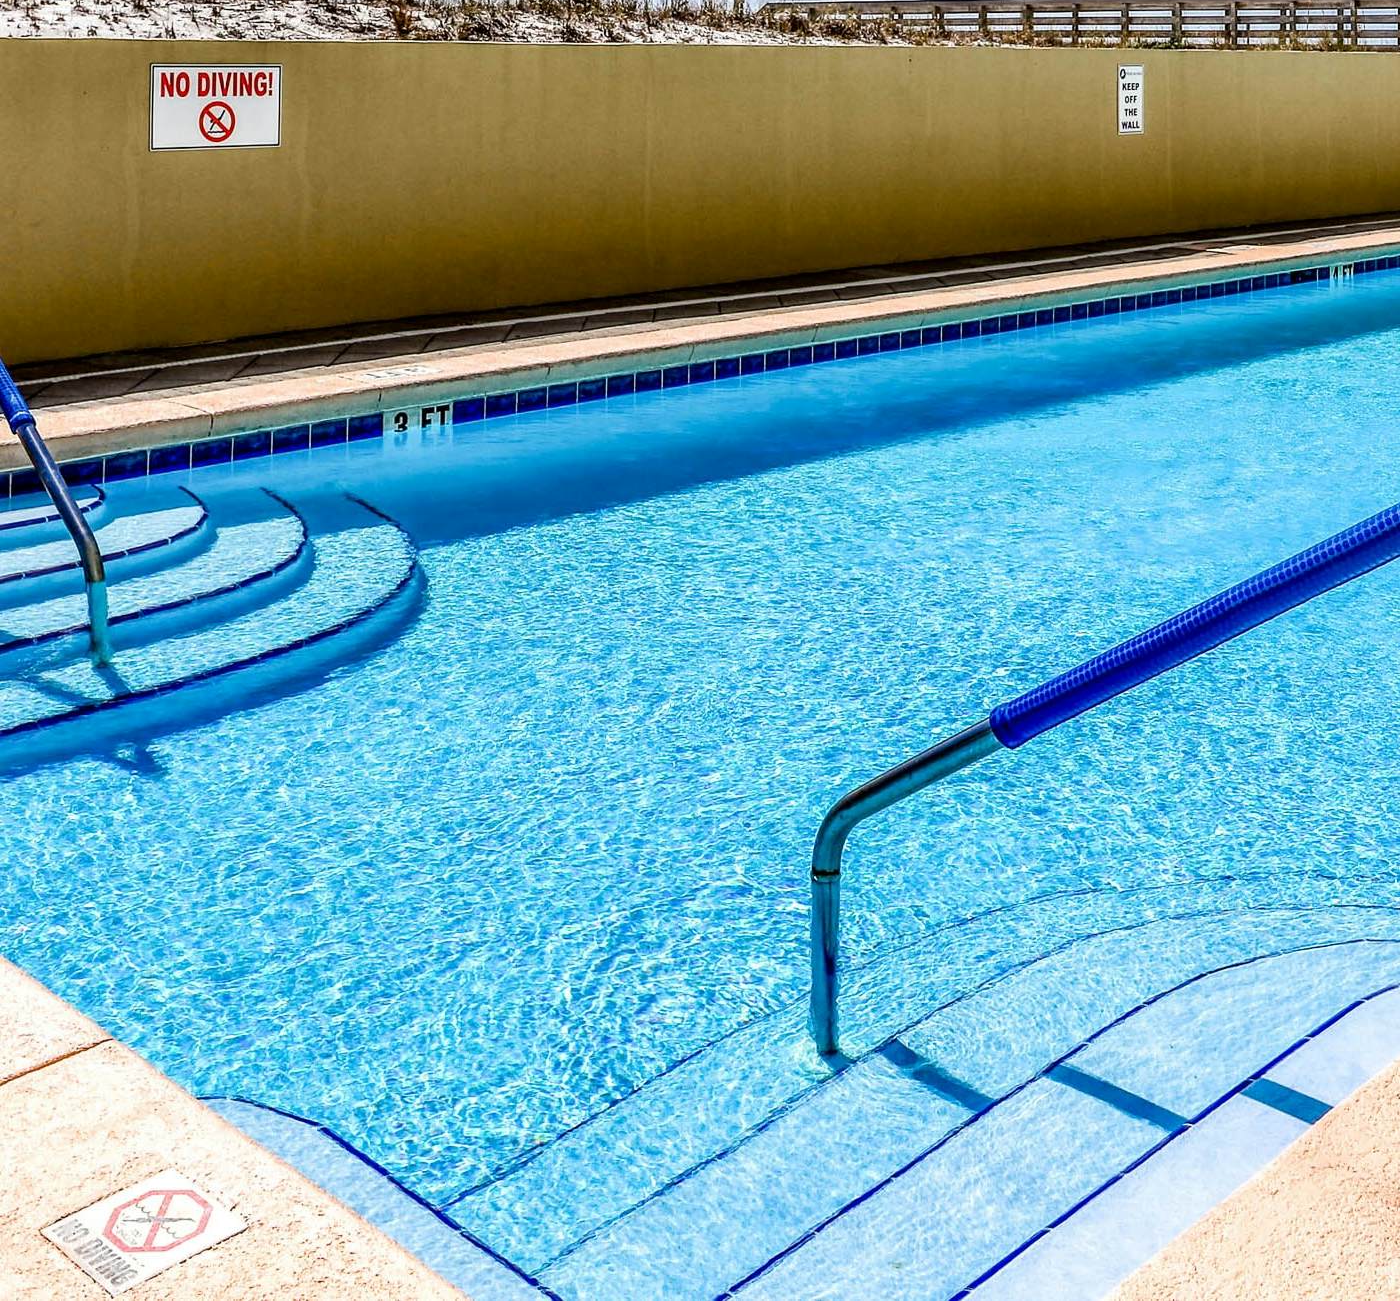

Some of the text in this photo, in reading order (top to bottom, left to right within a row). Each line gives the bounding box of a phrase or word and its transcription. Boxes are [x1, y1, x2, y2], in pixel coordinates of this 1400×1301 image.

[160, 72, 273, 97] NO DIVING!
[1122, 83, 1140, 91] KEEP
[1124, 95, 1138, 103] OFF
[1124, 108, 1138, 117] THE
[1121, 121, 1140, 129] WALL
[394, 404, 450, 432] 3 FT
[52, 1218, 89, 1243] NO
[73, 1237, 138, 1286] DIVING
